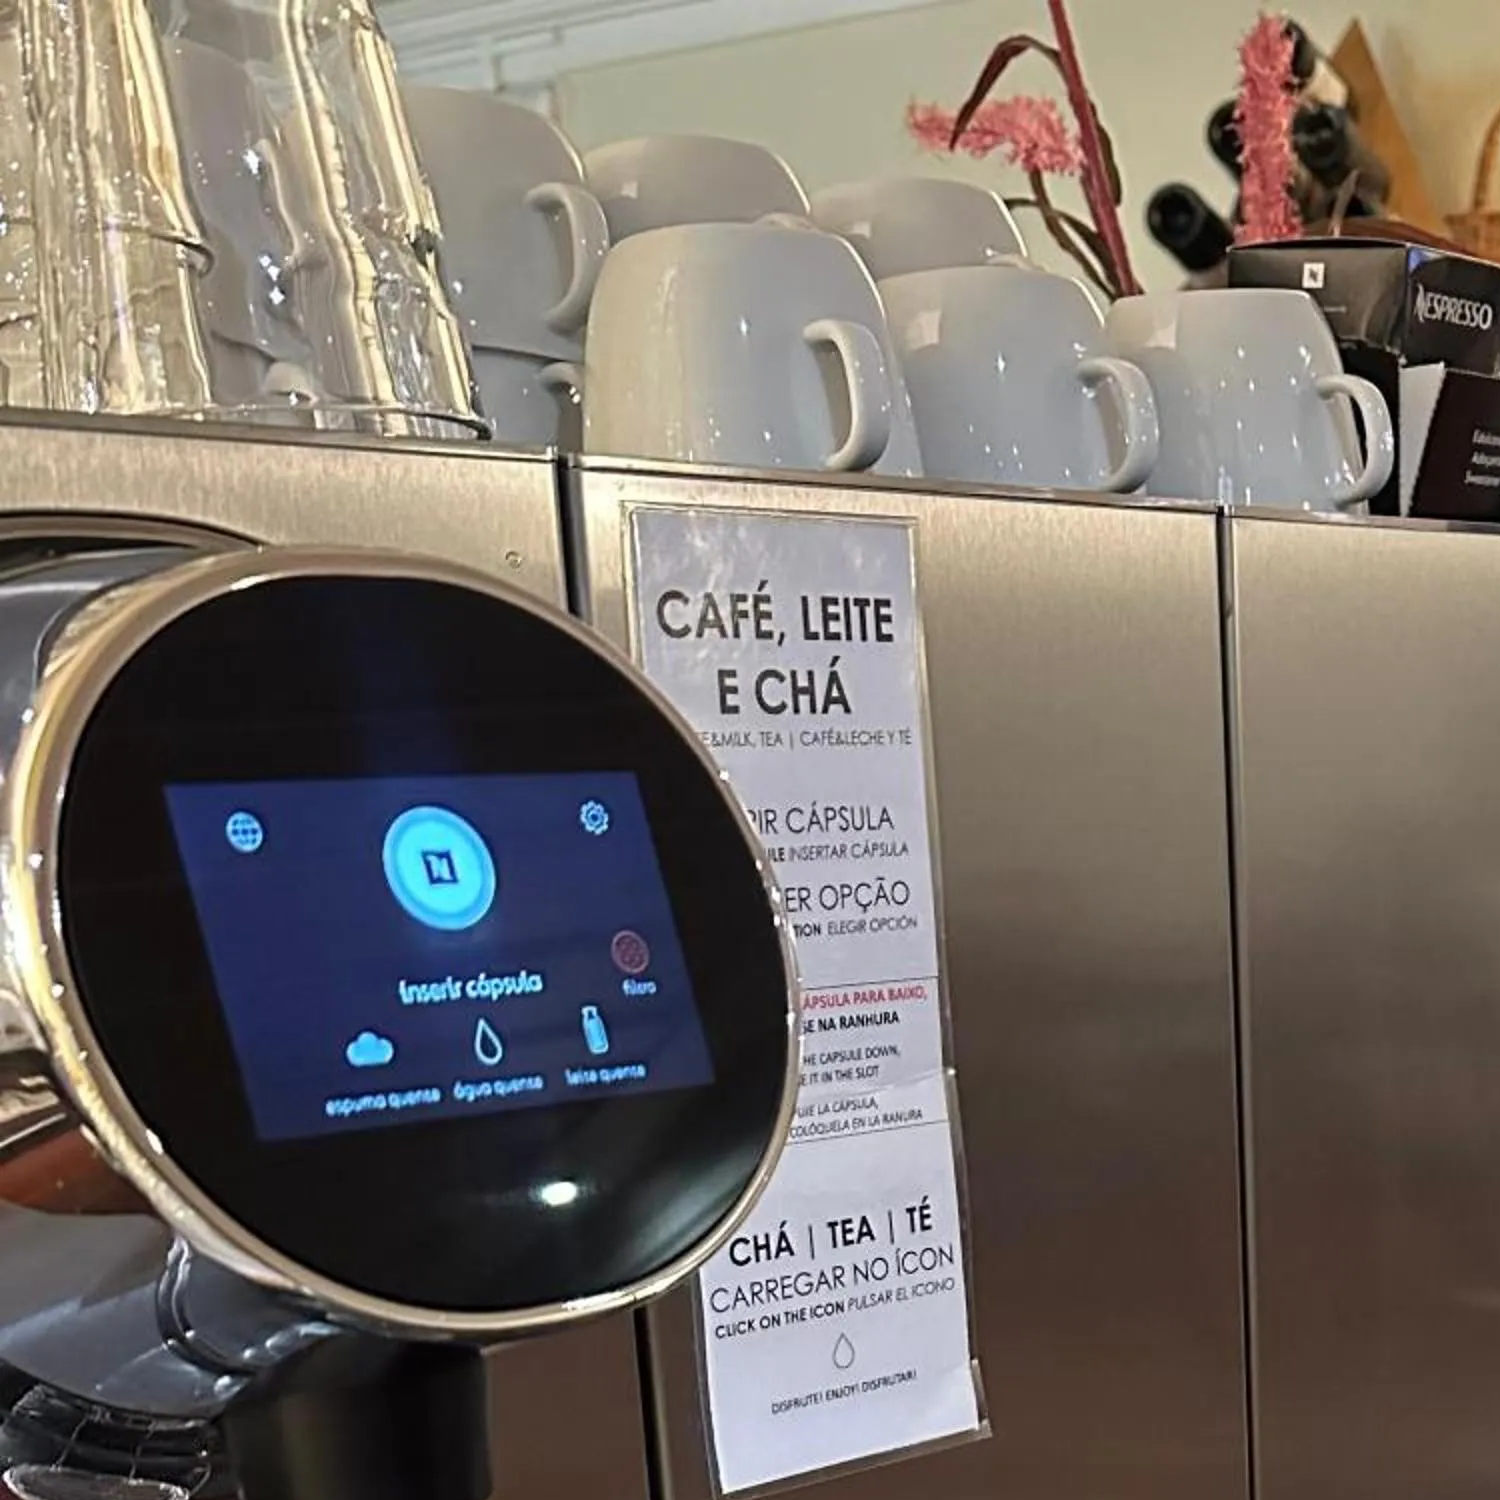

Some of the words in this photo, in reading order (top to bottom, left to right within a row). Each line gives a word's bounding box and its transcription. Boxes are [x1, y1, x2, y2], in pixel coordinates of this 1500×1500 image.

[1414, 282, 1493, 331] NESPRESSO
[657, 580, 785, 647] CAFÉ,
[801, 595, 895, 643] LEITE
[717, 668, 741, 715] E
[754, 655, 853, 715] CHÁ
[760, 731, 784, 747] TEA
[785, 800, 895, 834] CÁPSULA
[788, 843, 848, 863] INSERTAR
[851, 839, 910, 859] CÁPSULA
[818, 876, 911, 914] OPÇÃO
[827, 917, 867, 935] ELEGIR
[869, 914, 918, 934] OPCIÓN
[399, 975, 462, 1006] Inserir
[464, 969, 544, 1003] cápsula
[852, 988, 886, 1006] PARA
[888, 985, 928, 1003] BAIXO,
[817, 1016, 837, 1032] NA
[839, 1010, 901, 1029] RANHURA
[819, 1047, 862, 1065] CAPSULE
[821, 1071, 833, 1083] IN
[835, 1068, 852, 1081] THE
[855, 1065, 880, 1080] SLOT
[817, 1102, 830, 1115] LA
[852, 1117, 865, 1131] EN
[867, 1114, 881, 1128] LA
[729, 1220, 795, 1267] CHÁ
[826, 1215, 876, 1249] TEA
[905, 1195, 932, 1234] TÉ
[710, 1264, 846, 1314] CARREGAR
[852, 1257, 889, 1286] NO
[714, 1318, 756, 1339] CLICK
[759, 1312, 781, 1330] ON
[783, 1307, 807, 1325] THE
[809, 1299, 846, 1319] ICON
[847, 1288, 893, 1312] PULSAR
[895, 1287, 909, 1302] EL
[911, 1276, 956, 1299] ICONO
